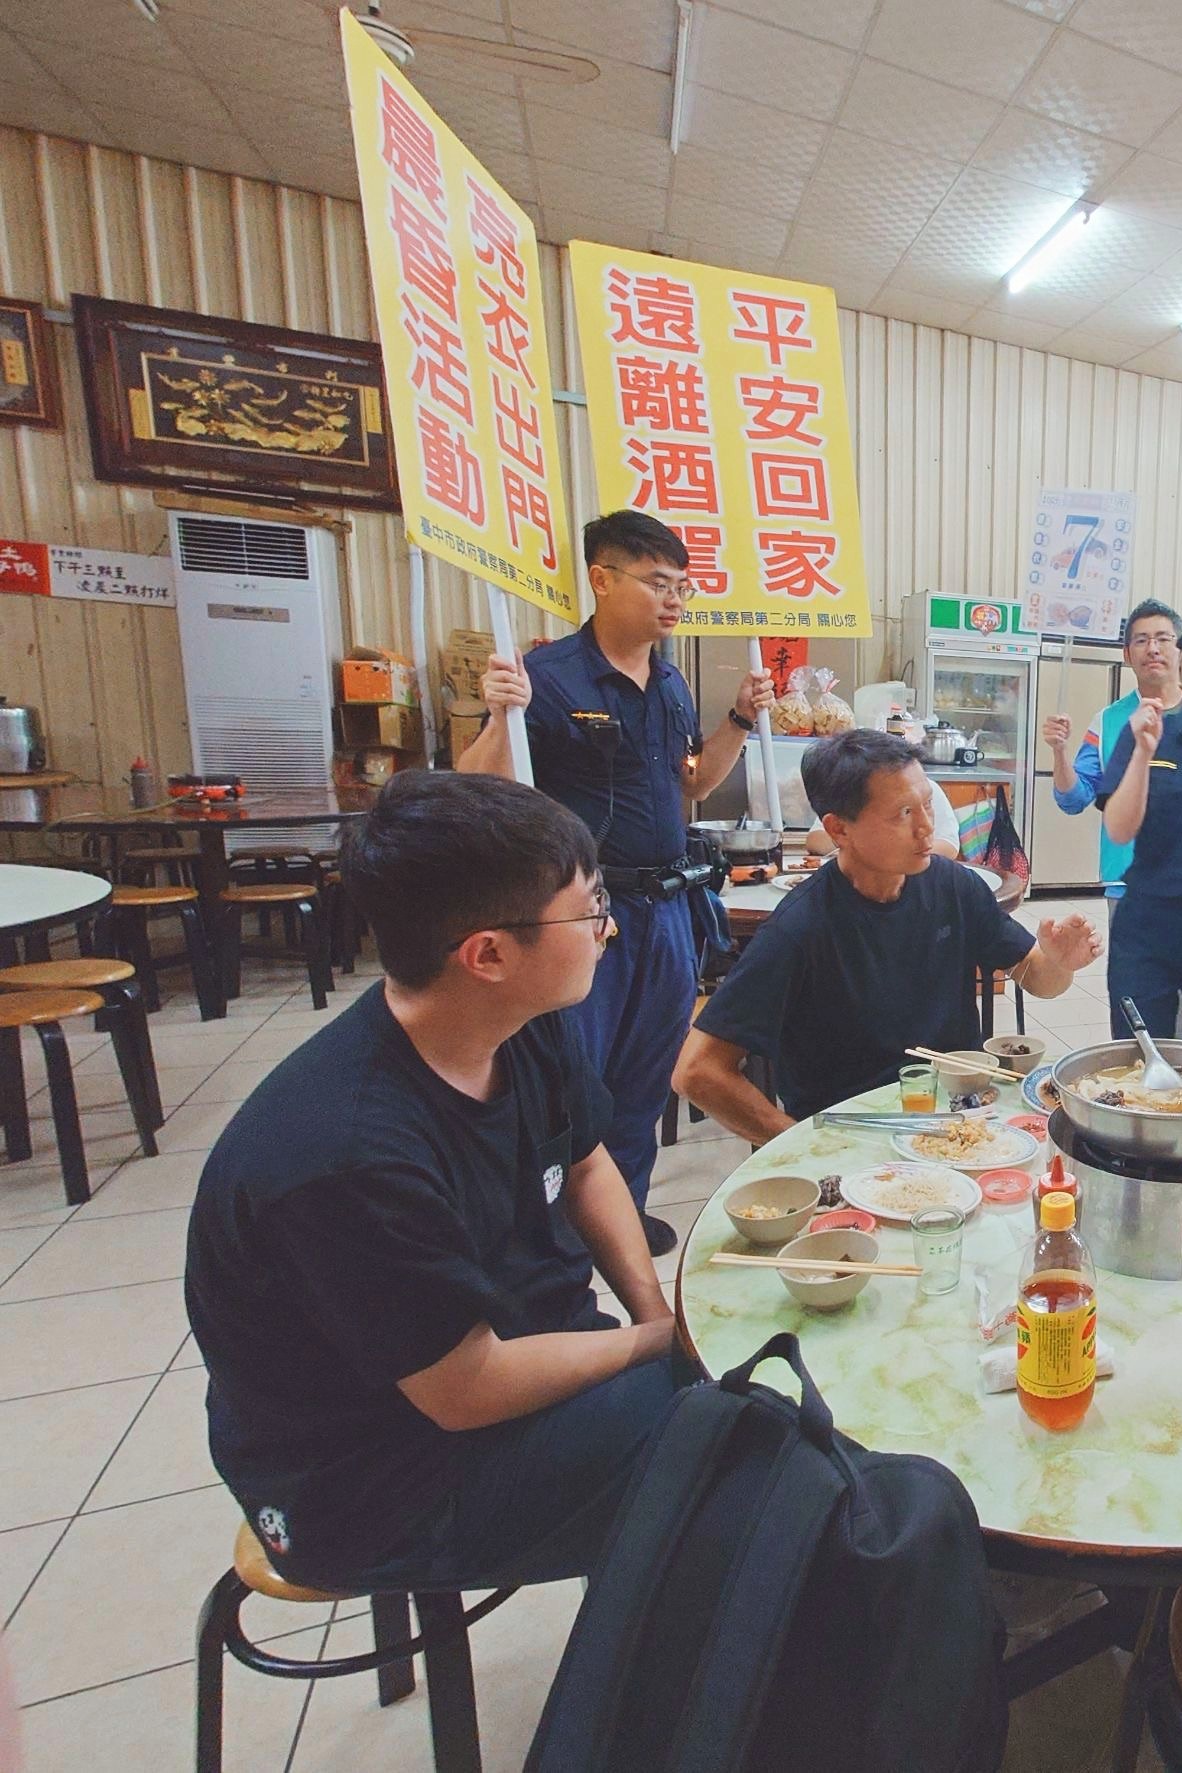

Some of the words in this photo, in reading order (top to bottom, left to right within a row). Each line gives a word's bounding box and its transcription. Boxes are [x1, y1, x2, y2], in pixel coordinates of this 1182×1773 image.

[381, 76, 485, 528] 晨昏活動
[466, 176, 558, 570] 亮衣出門
[731, 292, 841, 597] 平安回家
[1063, 515, 1099, 579] 7
